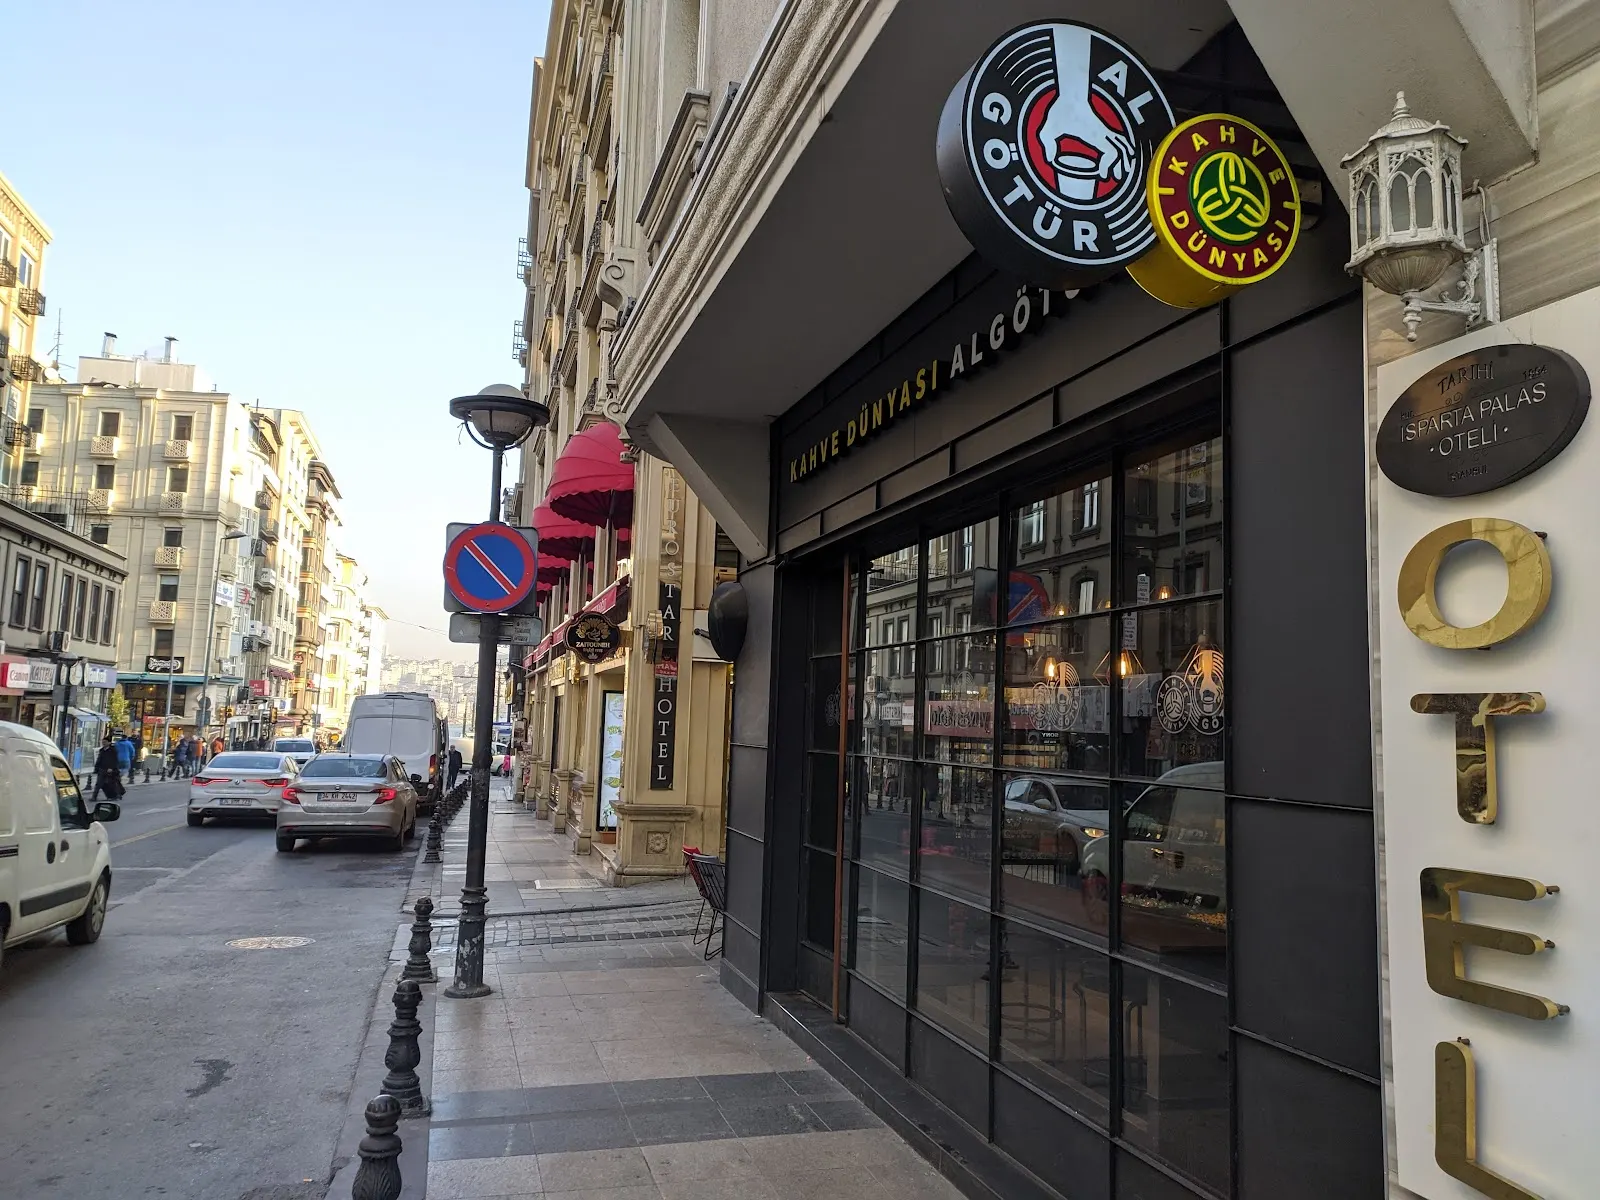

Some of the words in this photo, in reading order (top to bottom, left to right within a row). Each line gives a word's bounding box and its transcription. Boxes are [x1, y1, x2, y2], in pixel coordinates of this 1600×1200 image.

[1097, 60, 1154, 125] AL
[982, 92, 1100, 252] GÖTÜR
[1170, 125, 1286, 185] KAHVE
[1171, 211, 1290, 271] DÜNYASI
[790, 430, 839, 483] KAHVE
[847, 359, 938, 447] DÜNYASI
[1401, 405, 1475, 443] ISPARTA
[1480, 382, 1547, 419] PALAS
[9, 669, 28, 682] Canon
[656, 677, 673, 781] HOTEL
[1398, 518, 1562, 1200] OTEL
